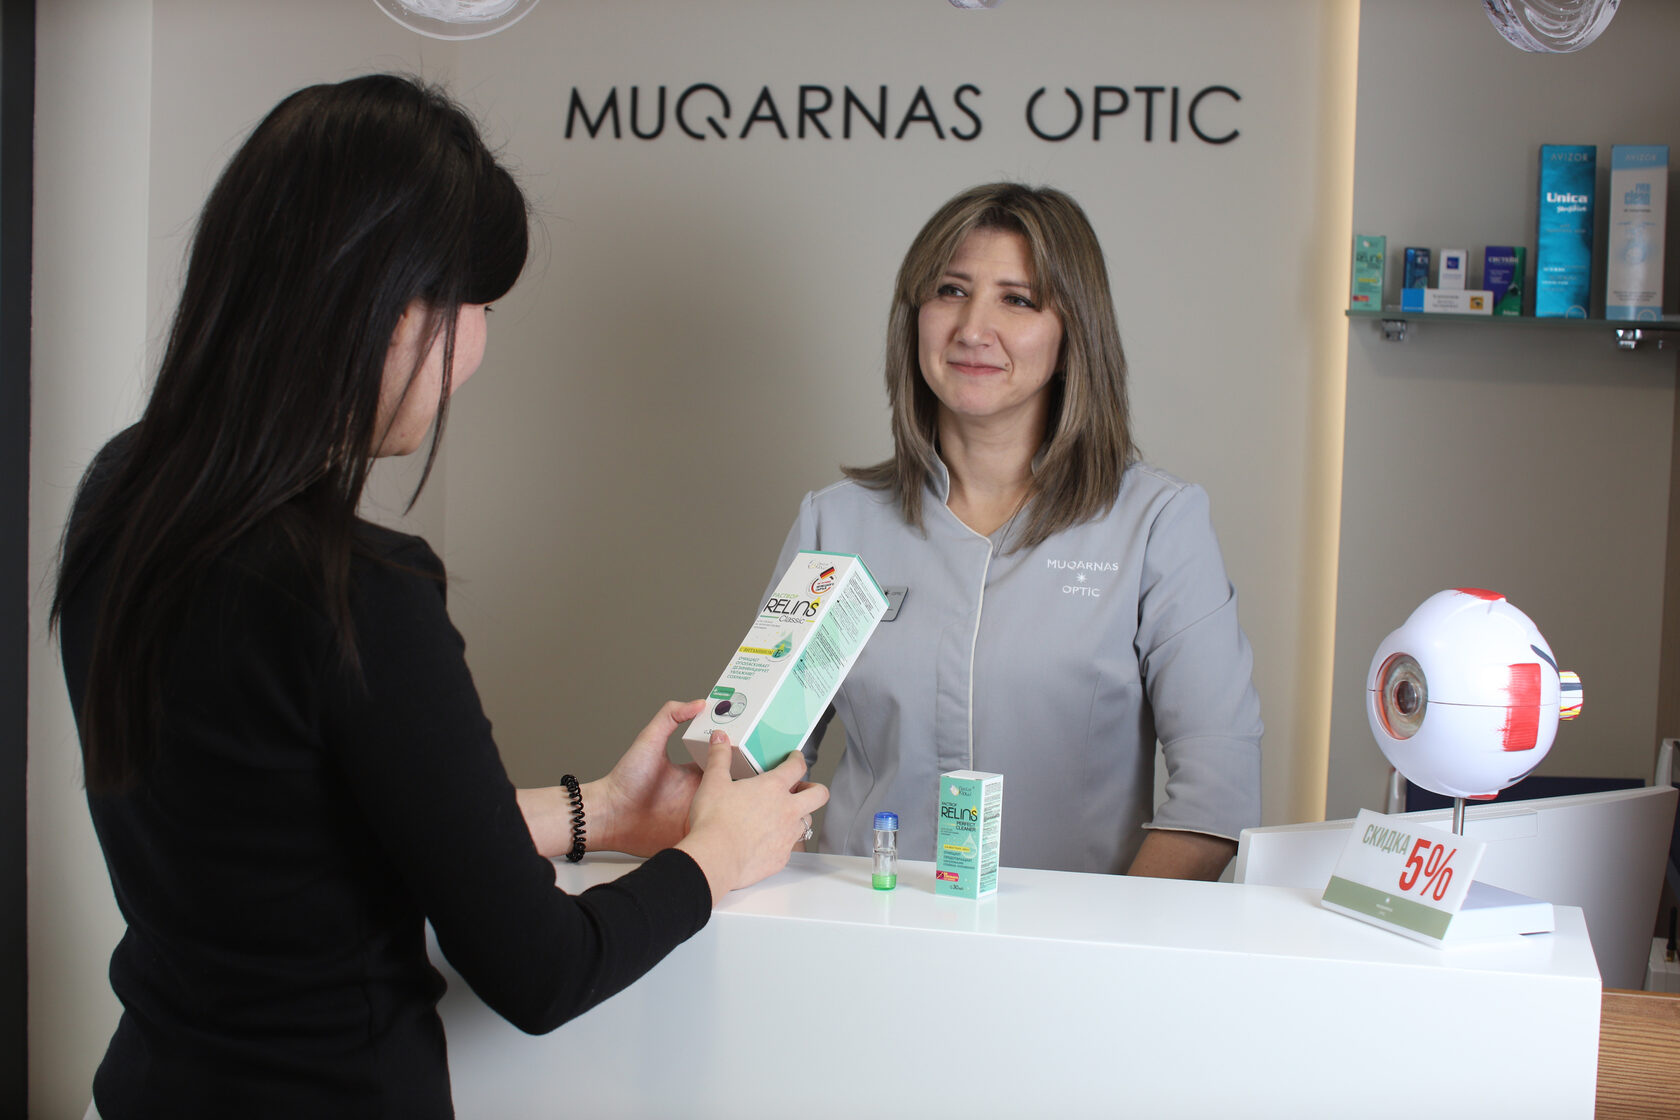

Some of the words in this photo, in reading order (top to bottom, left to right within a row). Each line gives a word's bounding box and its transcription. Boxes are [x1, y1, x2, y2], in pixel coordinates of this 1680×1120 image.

[564, 82, 983, 141] MUQARNAS
[1025, 84, 1242, 145] OPTIC
[1551, 152, 1588, 162] AVIZOR
[1546, 192, 1588, 203] Unica
[1047, 559, 1119, 571] MUQARNAS
[1062, 585, 1100, 597] OPTIC
[779, 615, 806, 625] Classic
[1363, 824, 1412, 855] СКИДКА
[1399, 838, 1457, 901] 5%
